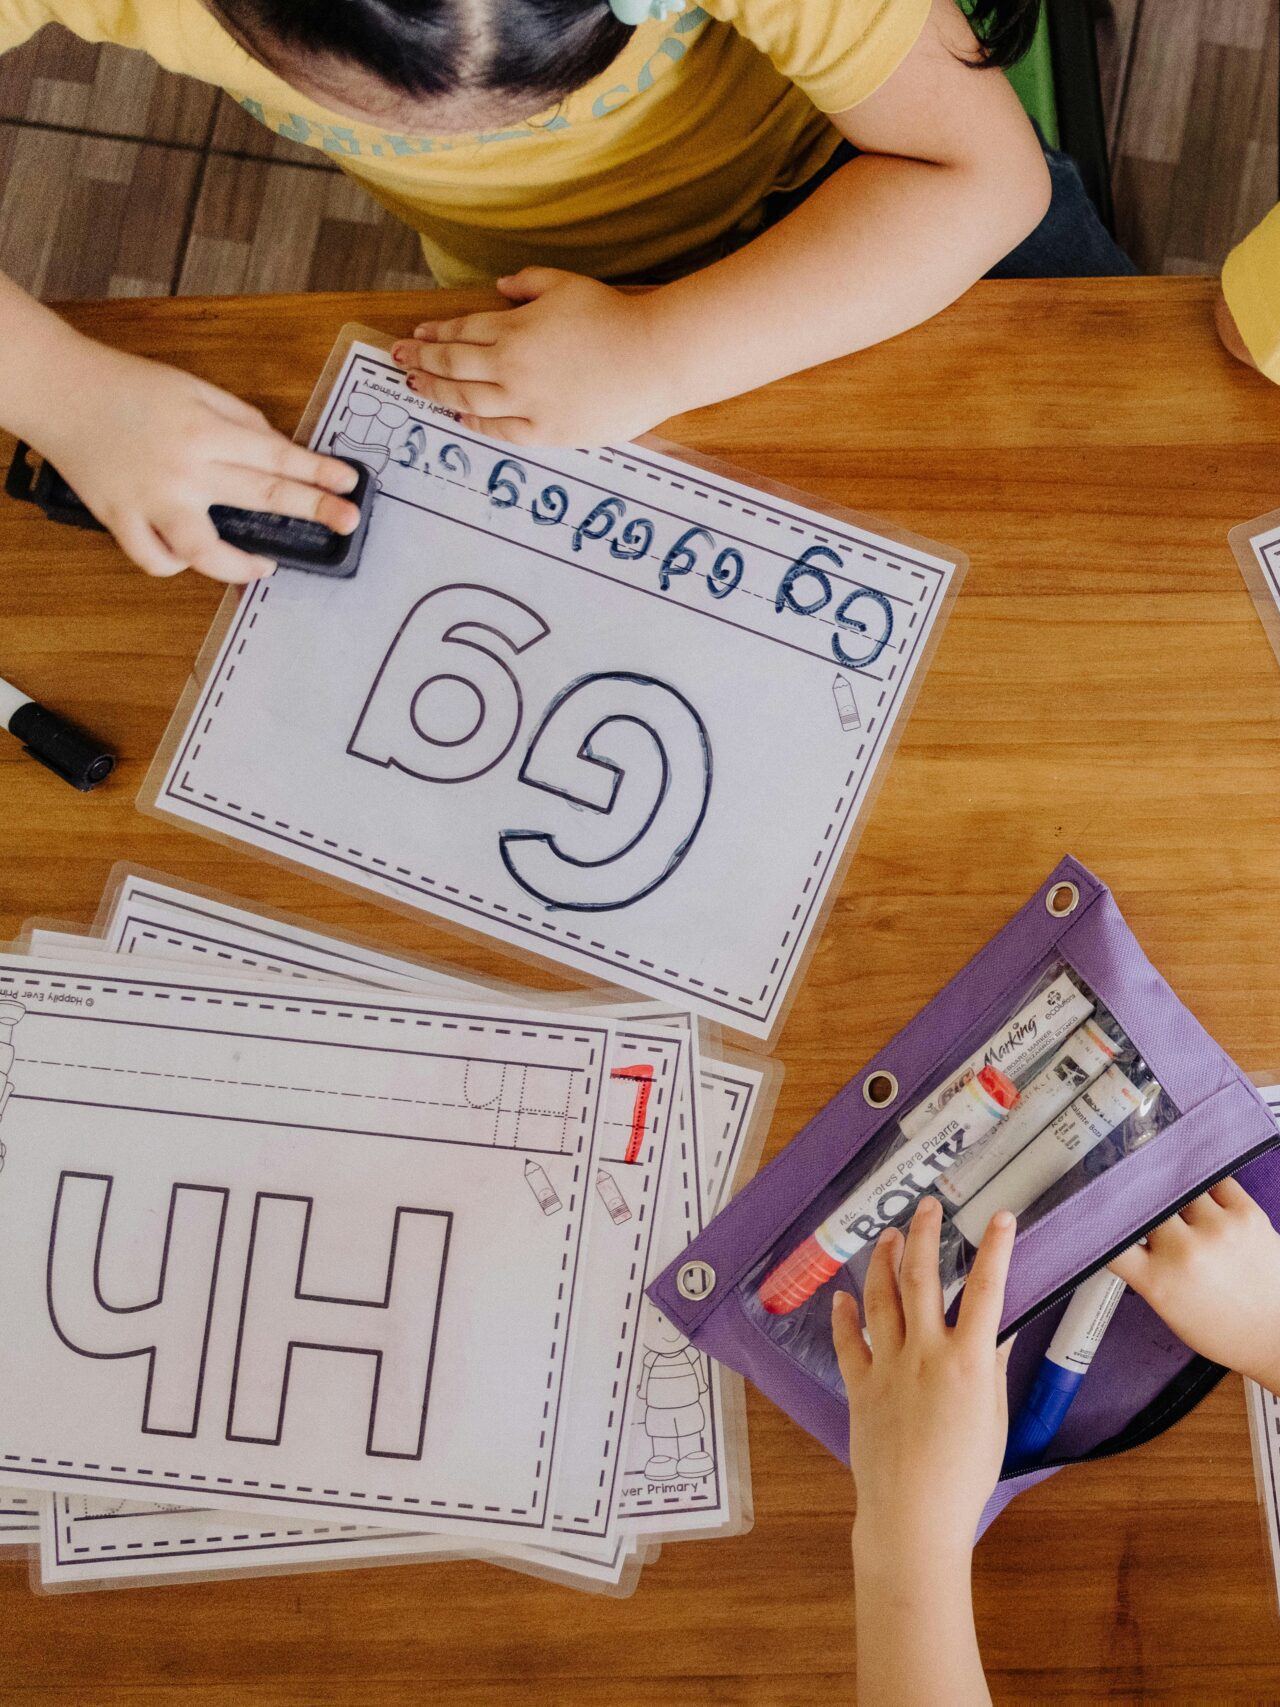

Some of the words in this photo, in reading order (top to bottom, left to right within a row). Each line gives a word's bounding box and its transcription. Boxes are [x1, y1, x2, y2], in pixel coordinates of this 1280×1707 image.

[362, 379, 401, 400] Primary
[402, 395, 425, 409] Ever
[427, 403, 454, 418] appily
[348, 583, 713, 908] Gg
[21, 992, 45, 1001] Ever
[48, 992, 83, 1005] Happily
[984, 1019, 1034, 1065] Marking
[892, 1151, 925, 1180] Para
[923, 1120, 960, 1154] Pizarra
[47, 1171, 452, 1459] Hh
[621, 1487, 643, 1496] ver
[647, 1482, 697, 1494] Primary
